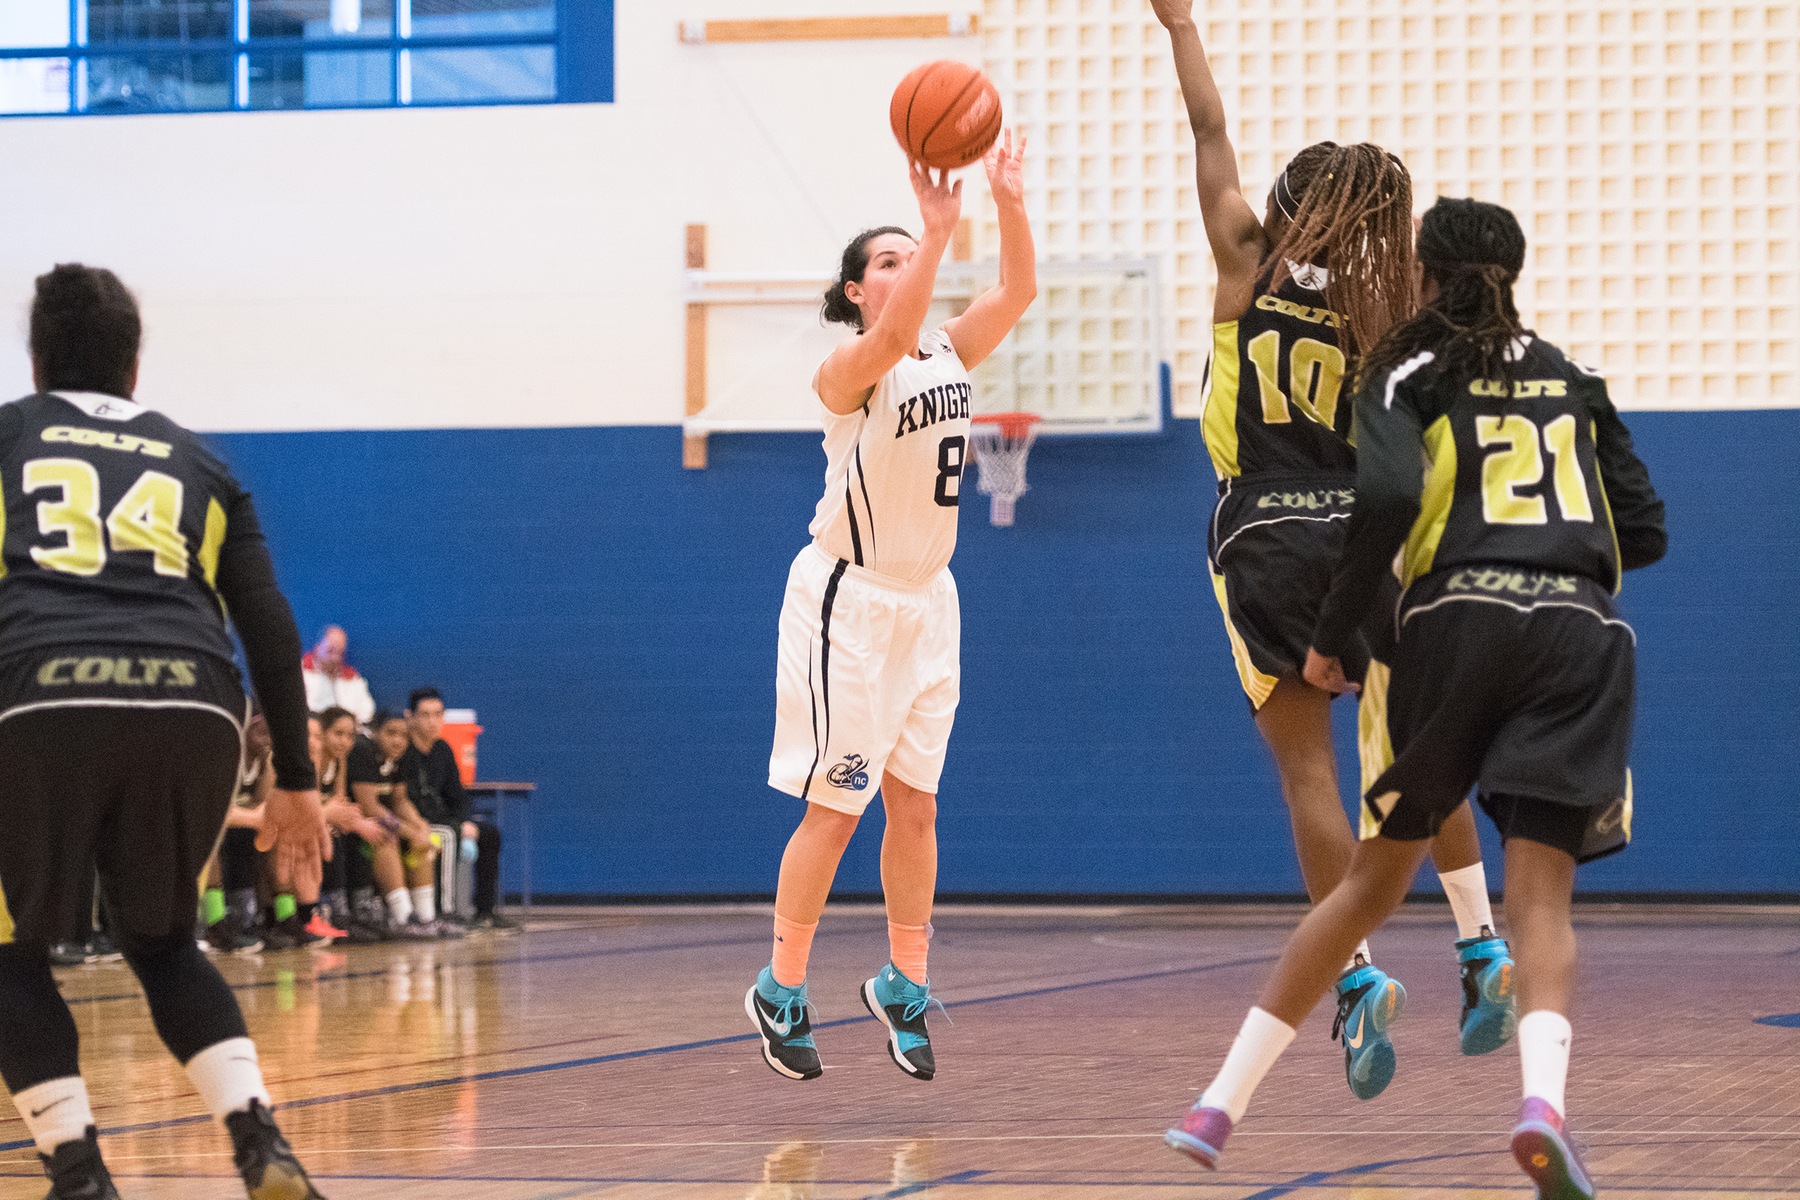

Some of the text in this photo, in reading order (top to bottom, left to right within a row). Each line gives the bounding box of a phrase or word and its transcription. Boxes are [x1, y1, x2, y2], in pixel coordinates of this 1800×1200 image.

[1255, 294, 1350, 329] COLTS
[1247, 329, 1346, 432] 10
[895, 382, 971, 438] KNIGH
[40, 426, 173, 458] COLTS
[934, 435, 965, 506] 8
[1475, 413, 1594, 525] 21
[1257, 488, 1356, 510] COLTS
[22, 458, 190, 579] 34
[1447, 568, 1577, 596] COLTS
[36, 656, 198, 686] COLTS
[854, 776, 867, 786] nc
